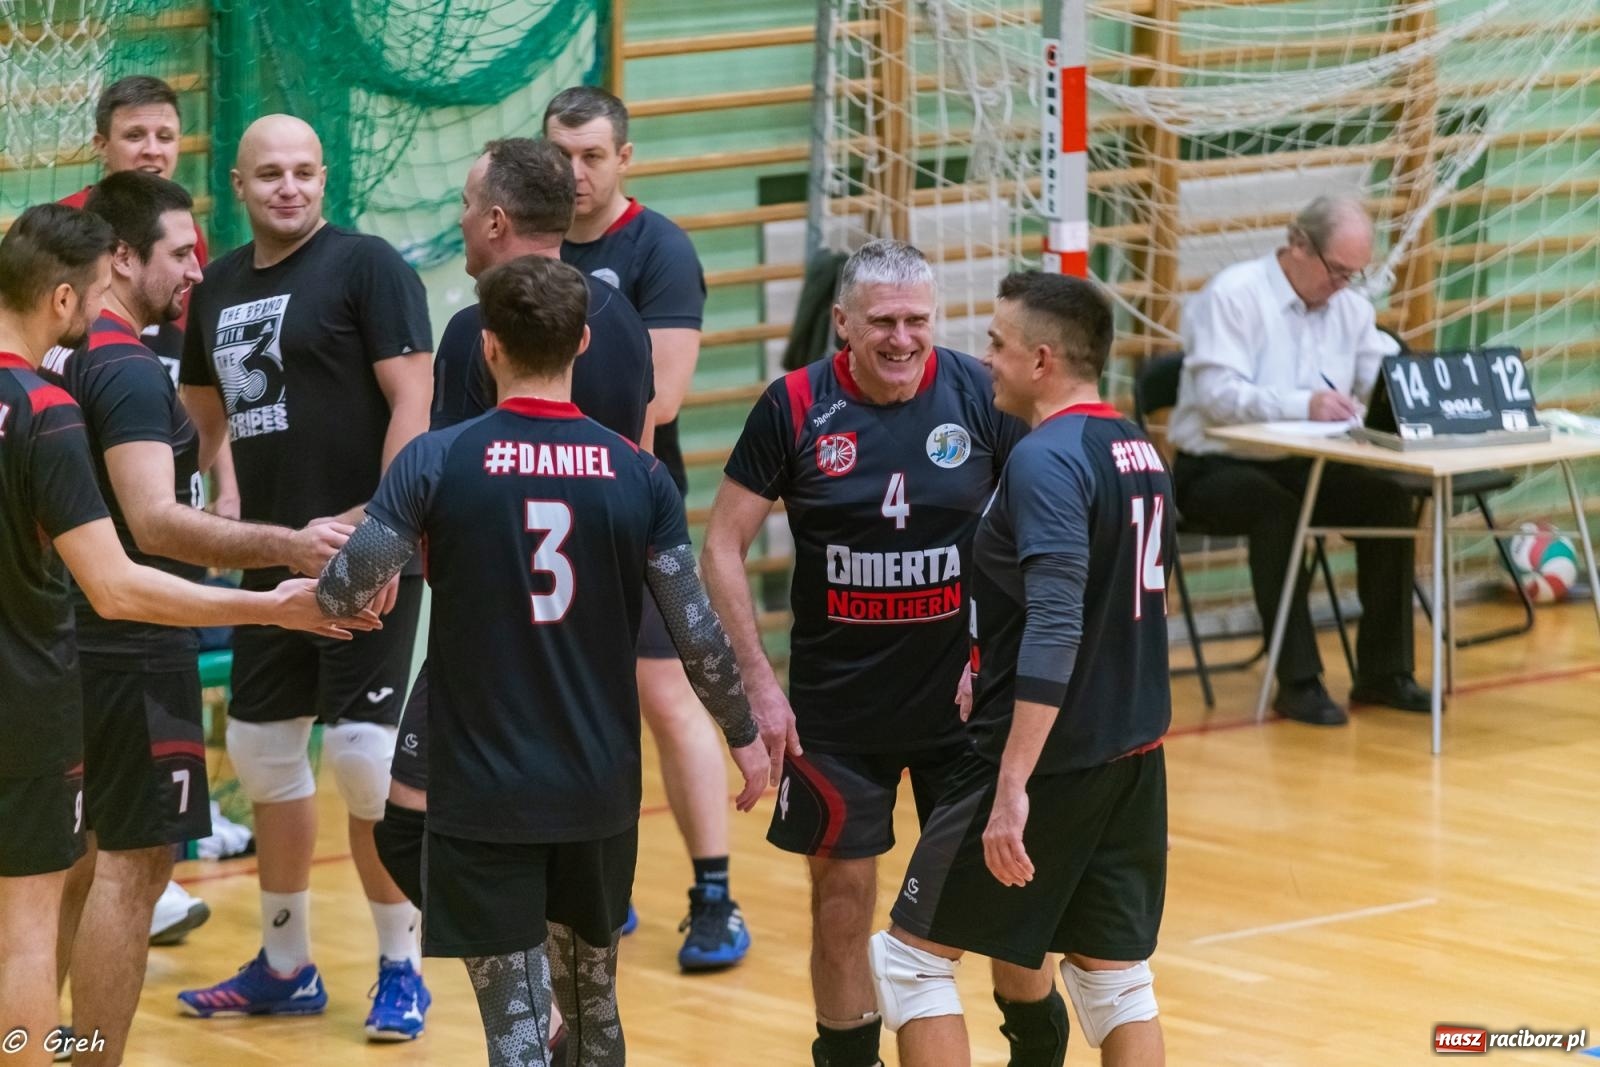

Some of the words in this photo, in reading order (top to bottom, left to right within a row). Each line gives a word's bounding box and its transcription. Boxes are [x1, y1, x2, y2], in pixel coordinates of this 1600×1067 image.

[222, 307, 241, 324] THE
[245, 298, 283, 320] BRAND
[216, 326, 245, 346] WITH
[216, 352, 236, 369] THE
[1390, 361, 1430, 410] 14
[1433, 356, 1452, 391] 0
[1462, 352, 1479, 386] 1
[1491, 354, 1532, 402] 12
[881, 471, 911, 530] 4
[525, 499, 576, 624] 3
[1130, 496, 1168, 621] 14
[171, 769, 190, 814] 7
[780, 775, 790, 820] 4
